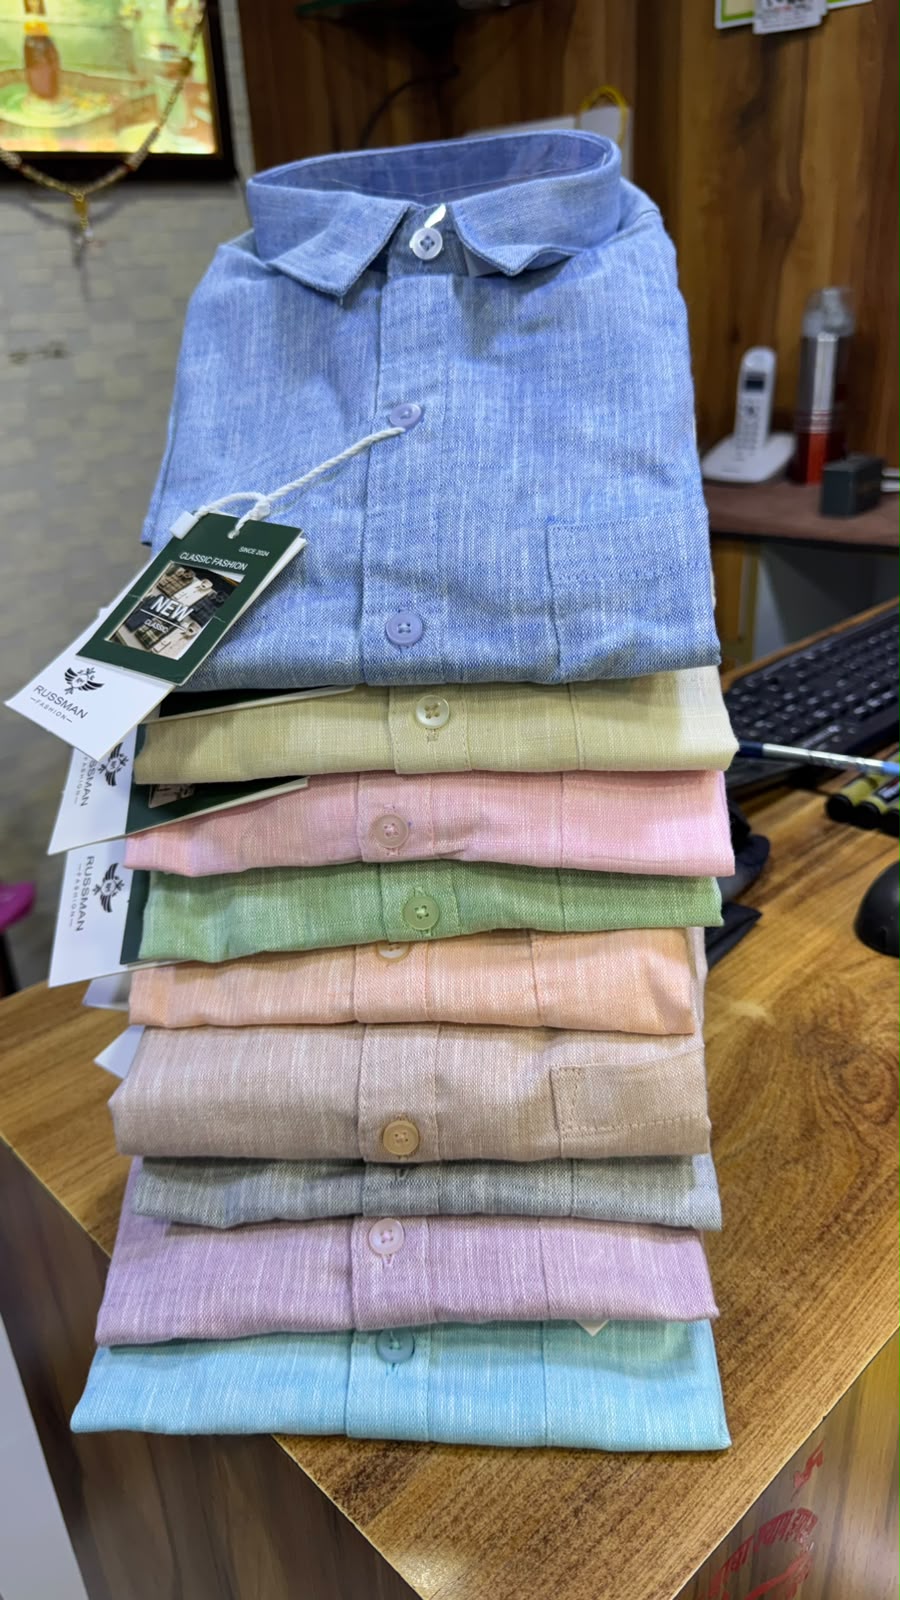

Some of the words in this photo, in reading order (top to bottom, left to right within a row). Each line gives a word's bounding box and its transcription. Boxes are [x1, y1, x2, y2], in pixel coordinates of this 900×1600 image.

[179, 551, 213, 565] CLASSIC
[211, 558, 249, 571] FASHION
[238, 546, 256, 555] SINCE
[256, 549, 270, 557] 2024
[150, 595, 194, 622] NEW
[143, 618, 169, 633] CLASSIC
[33, 684, 89, 719] RUSSMAN
[80, 759, 98, 807] SSMAN
[75, 855, 95, 931] RUSSMAN
